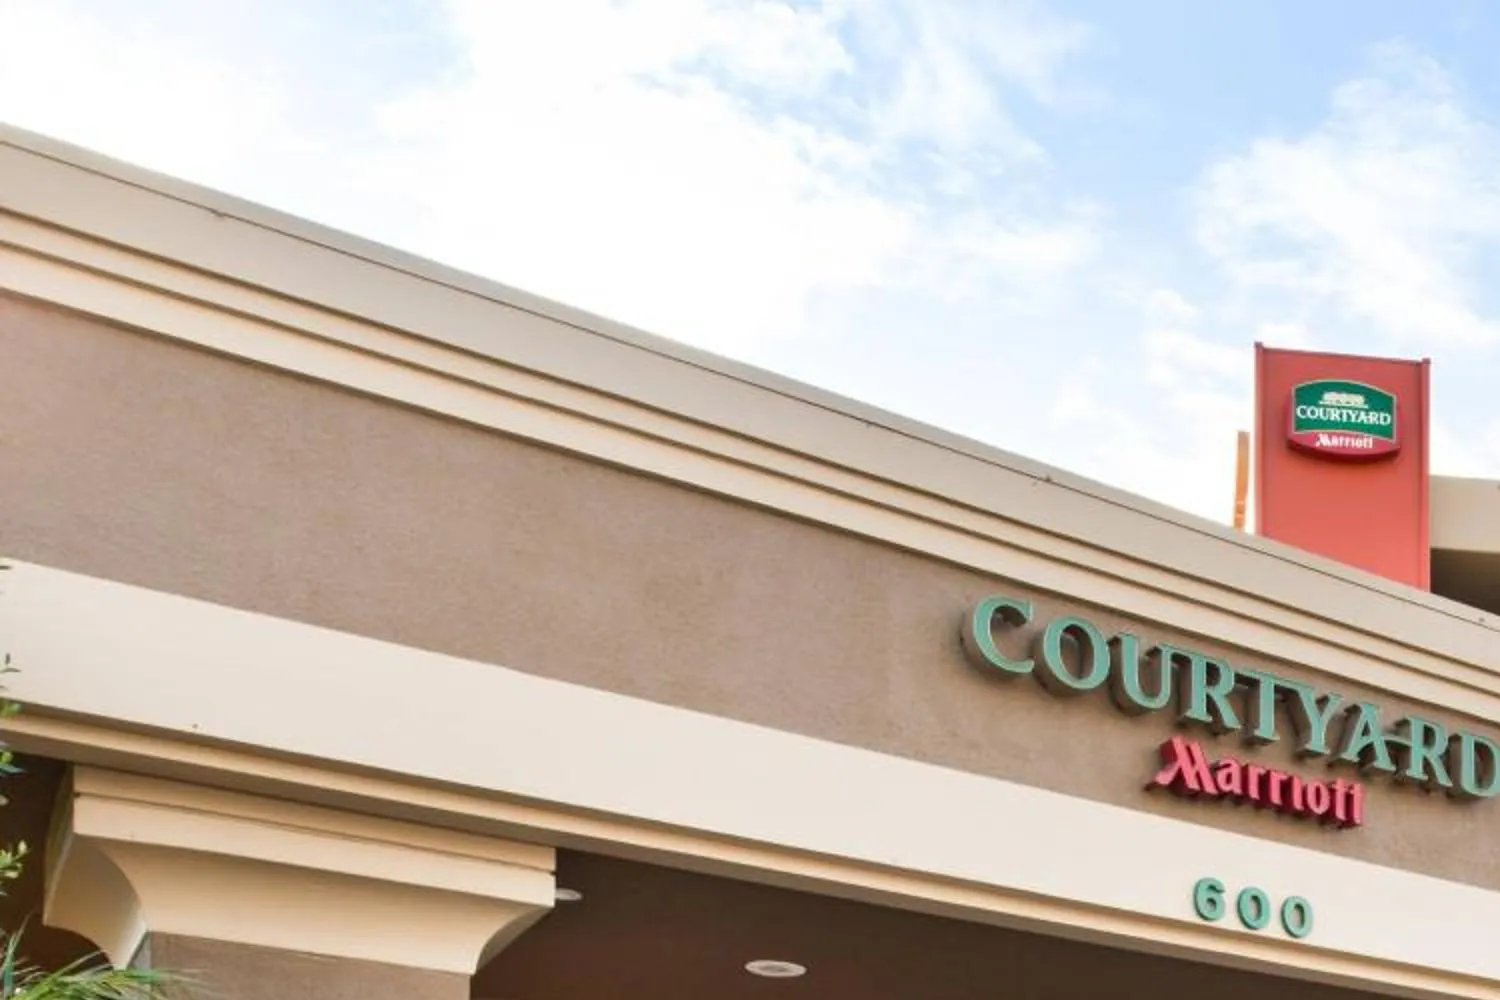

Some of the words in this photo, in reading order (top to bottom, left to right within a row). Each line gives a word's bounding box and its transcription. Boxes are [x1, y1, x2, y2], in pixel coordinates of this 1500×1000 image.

[1296, 405, 1391, 425] COURTYARD
[1315, 433, 1373, 448] Marriott
[1153, 735, 1364, 825] Marriott
[1194, 877, 1313, 938] 600
